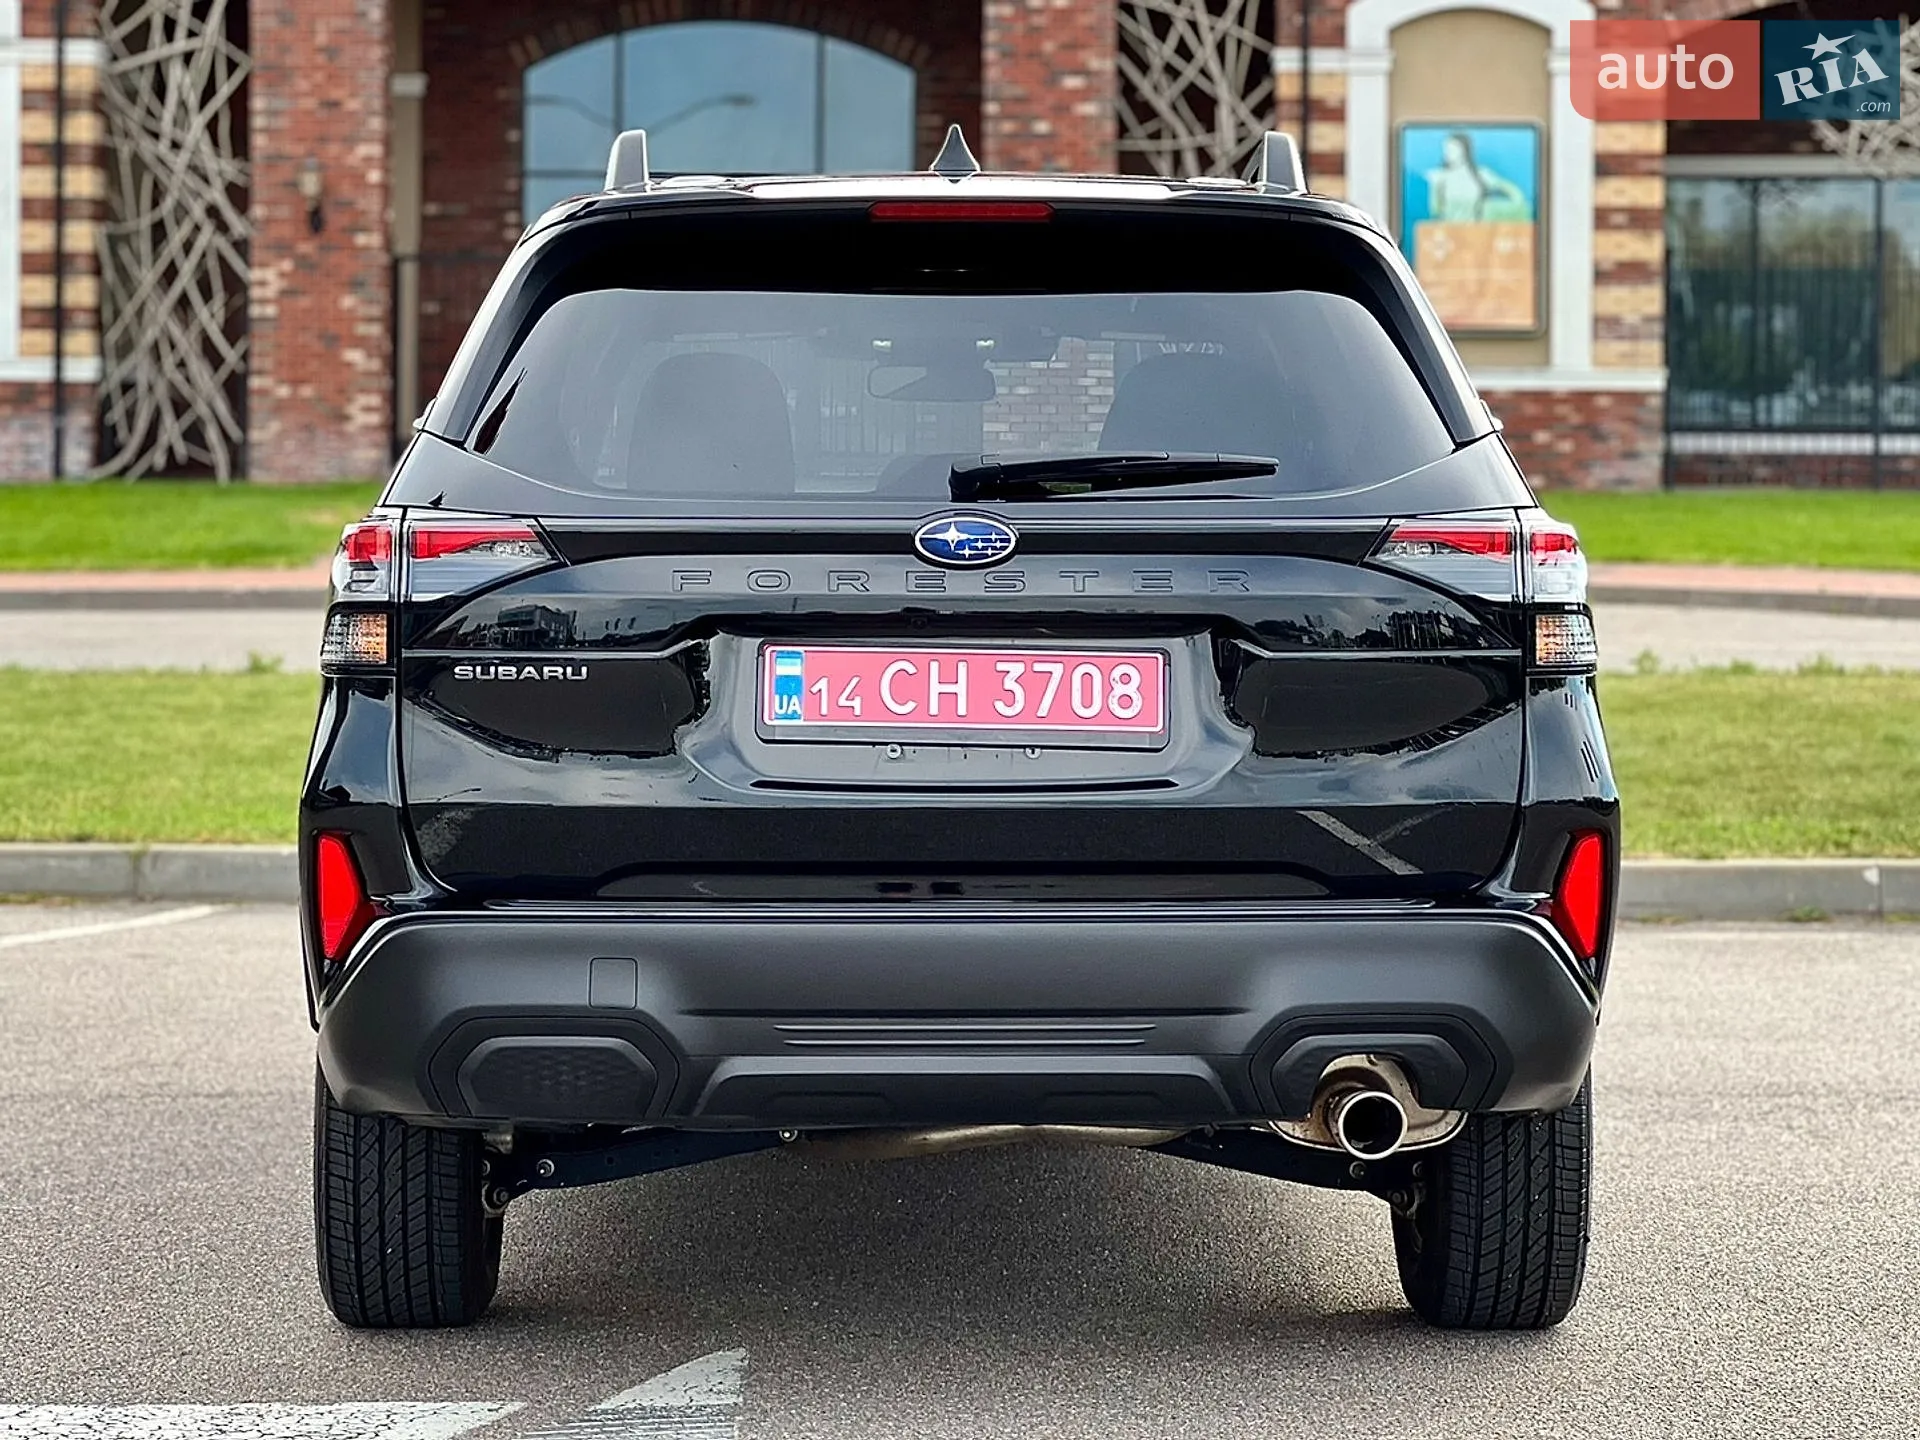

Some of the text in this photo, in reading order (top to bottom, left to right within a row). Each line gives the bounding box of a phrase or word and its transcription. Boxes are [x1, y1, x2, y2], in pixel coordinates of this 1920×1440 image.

[672, 569, 1251, 593] FORESTER
[453, 665, 588, 680] SUBARU
[809, 660, 1143, 720] 14 CH 3708
[774, 694, 801, 716] UA
